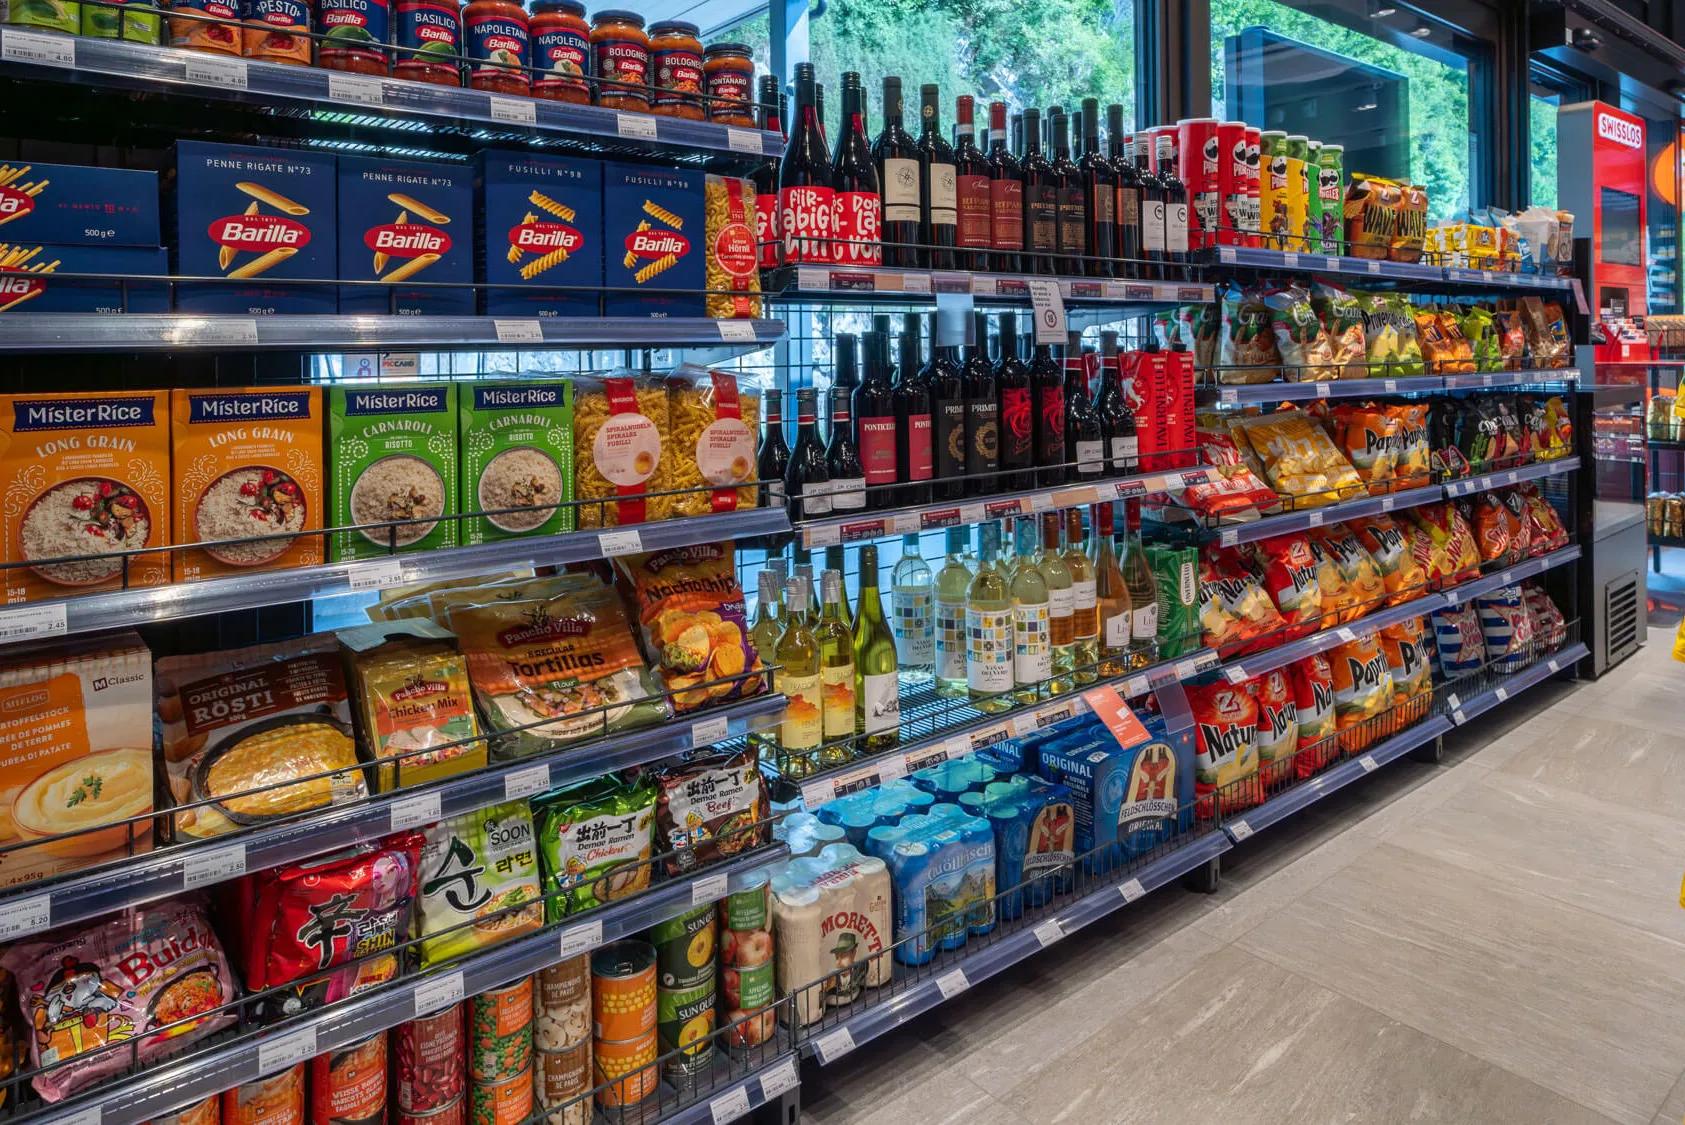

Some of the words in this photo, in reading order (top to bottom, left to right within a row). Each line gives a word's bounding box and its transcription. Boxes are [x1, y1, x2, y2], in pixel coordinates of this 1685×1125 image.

[209, 5, 233, 17] Barilla
[261, 1, 296, 17] PESTO
[321, 0, 367, 11] BASILICO
[267, 14, 291, 25] Barilla
[326, 13, 362, 25] Barilla
[415, 13, 456, 29] BASILICO
[421, 28, 453, 43] Barilla
[474, 24, 528, 40] NAPOLETANA
[489, 39, 520, 52] Barilla
[56, 55, 73, 63] 4.80
[552, 49, 582, 62] Barilla
[621, 61, 645, 73] Barilla
[677, 69, 699, 81] Barilla
[1601, 116, 1642, 145] SWISSLOS
[206, 158, 243, 170] PENNE
[246, 162, 284, 174] RIGATE
[287, 164, 311, 176] N°73
[508, 164, 552, 176] FUSILLI
[362, 172, 394, 183] PENNE
[397, 175, 428, 186] RIGATE
[625, 175, 663, 186] FUSILLI
[84, 229, 100, 237] 500
[221, 222, 299, 244] Barilla
[375, 231, 442, 251] Barilla
[518, 229, 575, 248] Barilla
[632, 236, 683, 254] Barilla
[362, 419, 433, 439] CARNAROLI
[488, 413, 552, 432] CARNAROLI
[606, 422, 652, 433] SPIRALNUDELN
[208, 427, 247, 448] LONG
[252, 426, 295, 444] GRAIN
[508, 432, 534, 442] RISOTTO
[606, 431, 637, 441] SPIRALES
[607, 439, 632, 448] FUSILLI
[36, 437, 80, 459] LONG
[86, 434, 137, 453] GRAIN
[384, 439, 413, 450] RISOTTO
[691, 544, 719, 558] Villa
[1291, 541, 1306, 558] Z
[8, 596, 26, 604] min
[503, 622, 552, 645] Pancho
[552, 620, 584, 635] Villa
[505, 651, 606, 679] Tortillas
[108, 672, 144, 687] Classic
[551, 679, 577, 690] Flour
[1270, 672, 1283, 694] Z
[189, 677, 269, 706] ORIGINAL
[394, 684, 426, 702] Pancho
[426, 681, 447, 694] Villa
[192, 690, 274, 724] RÖSTI
[388, 698, 436, 720] Chicken
[437, 696, 459, 711] Mix
[1218, 691, 1240, 714] Z
[18, 728, 31, 741] DE
[32, 718, 72, 738] POMMES
[11, 740, 24, 752] DE
[24, 733, 54, 749] TERRE
[38, 742, 72, 758] PATATE
[1041, 751, 1094, 779] ORIGINAL
[686, 769, 741, 798] 出前一丁
[690, 793, 717, 805] Demae
[718, 785, 744, 799] Ramen
[706, 798, 733, 814] Beef
[490, 823, 532, 846] SOON
[576, 815, 637, 844] 出前一丁
[577, 838, 607, 851] Demae
[607, 832, 635, 845] Ramen
[586, 845, 626, 862] Chicken
[495, 850, 533, 874] 라면
[30, 916, 48, 927] 5.20
[688, 917, 706, 934] SUN
[296, 893, 370, 970] 辛
[356, 930, 396, 951] SHIN
[114, 926, 216, 988] Buldak
[559, 987, 574, 997] PARIS
[678, 1005, 699, 1020] SUN
[563, 1077, 579, 1088] PARIS
[331, 1091, 364, 1107] HARICOTS
[332, 1084, 360, 1099] WEISSE
